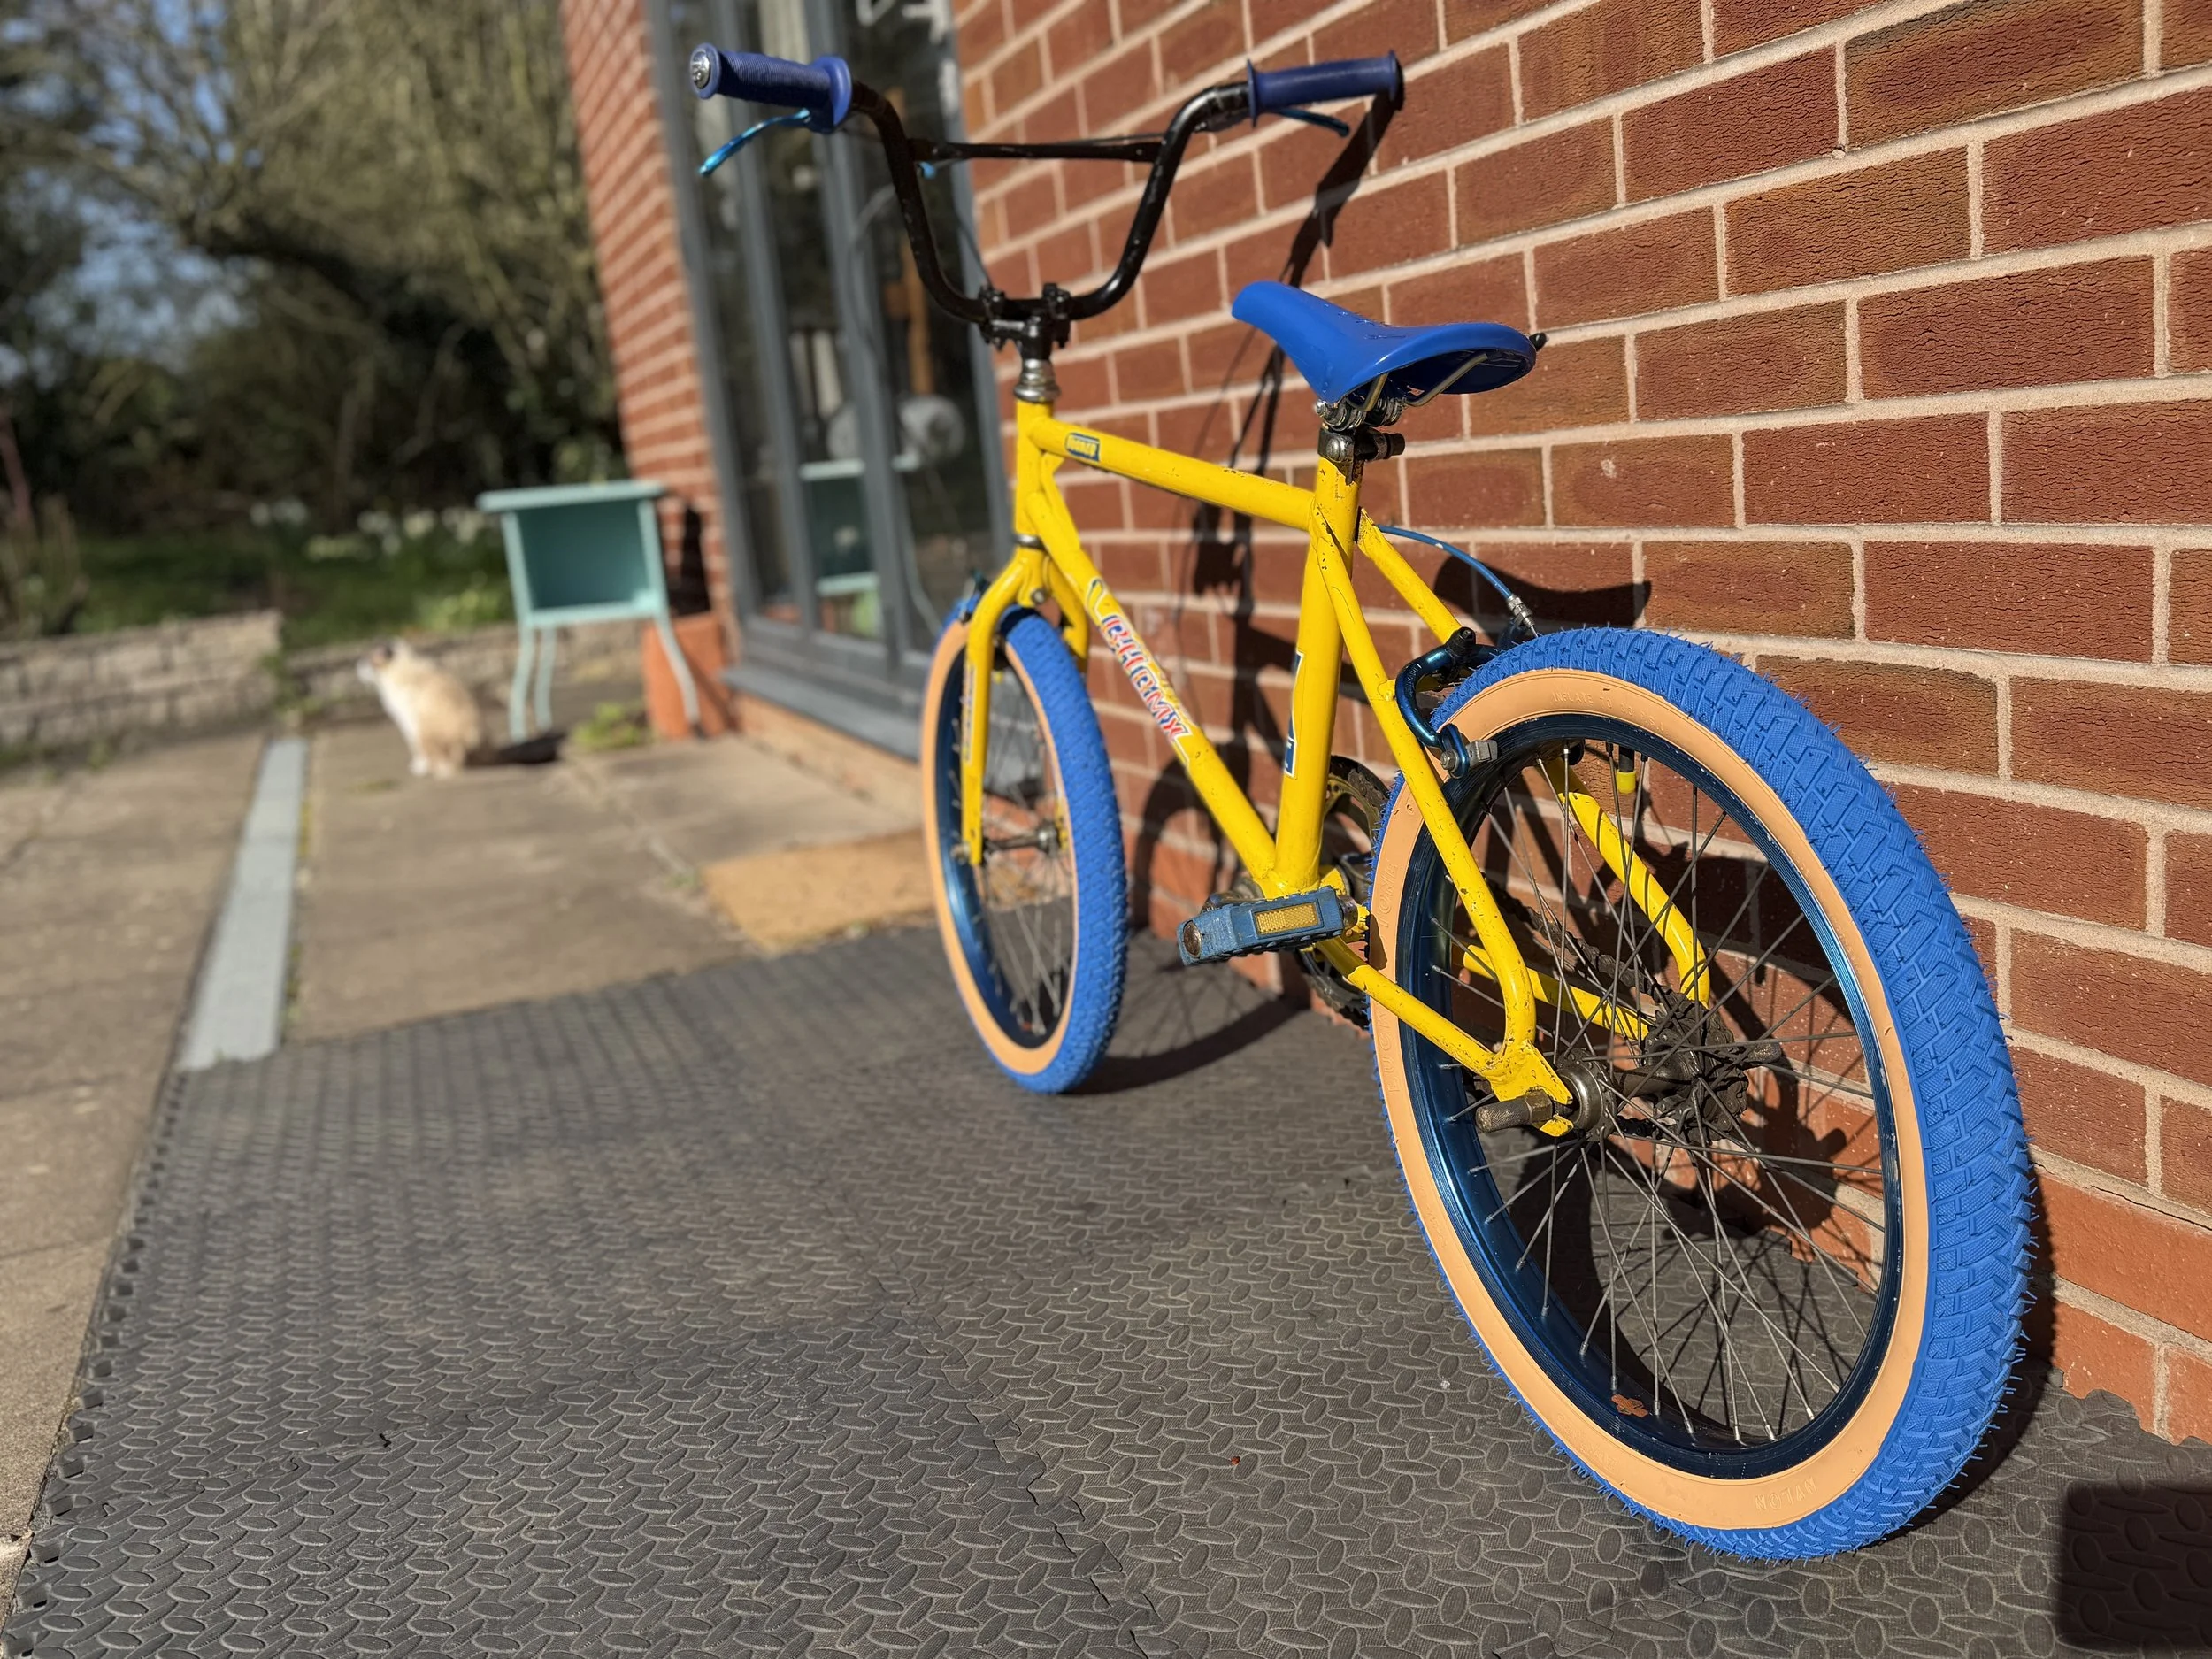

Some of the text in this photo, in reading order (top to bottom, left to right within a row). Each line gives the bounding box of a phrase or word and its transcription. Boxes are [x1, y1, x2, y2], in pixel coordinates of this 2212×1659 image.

[1552, 690, 1594, 703] INFLATE
[1599, 695, 1612, 709] TO
[1755, 1475, 1816, 1511] NYLON
